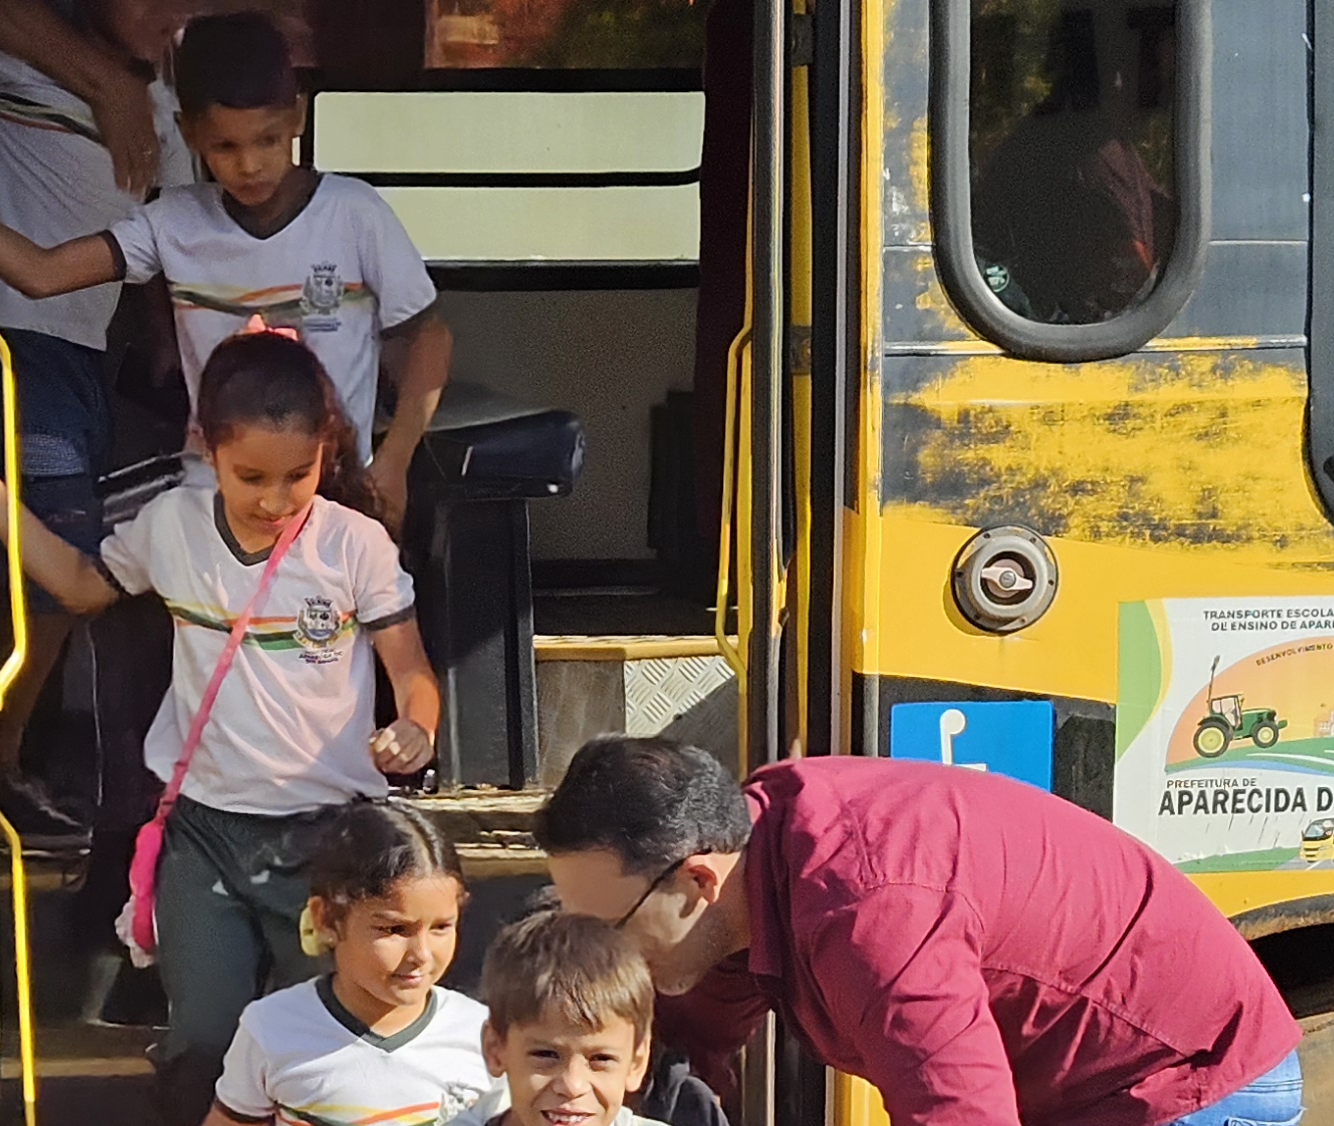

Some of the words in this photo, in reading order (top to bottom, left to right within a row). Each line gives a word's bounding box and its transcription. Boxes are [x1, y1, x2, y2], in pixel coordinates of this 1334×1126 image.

[1203, 608, 1283, 620] TRANSPORTE
[1230, 620, 1278, 631] ENSINO
[1281, 620, 1297, 630] DE
[1167, 778, 1239, 789] PREFEITURA
[1242, 778, 1257, 787] DE
[1158, 787, 1308, 816] APARECIDA
